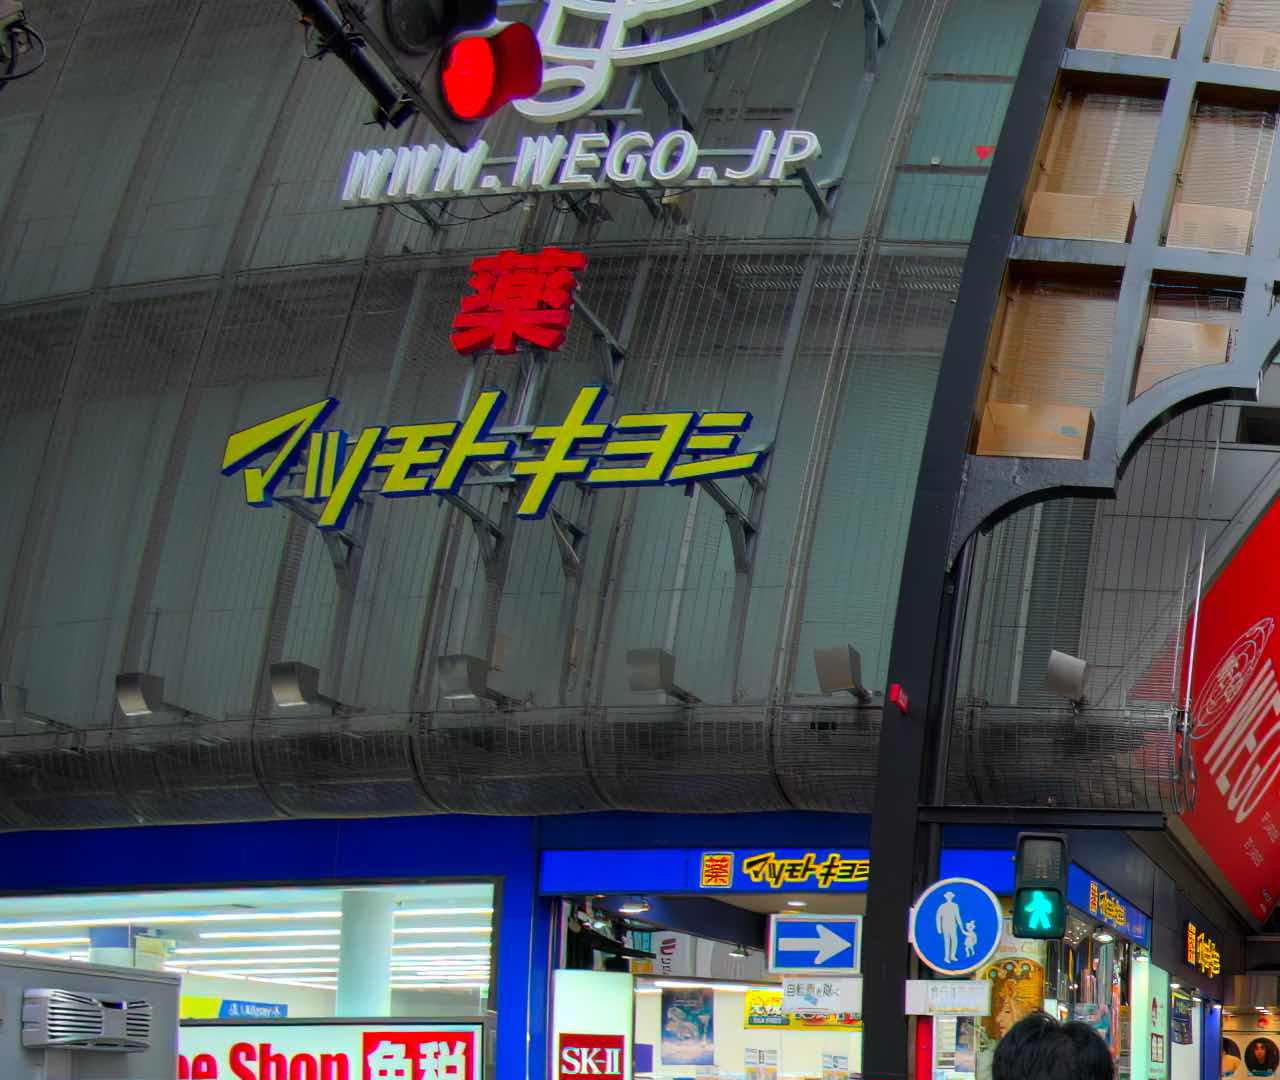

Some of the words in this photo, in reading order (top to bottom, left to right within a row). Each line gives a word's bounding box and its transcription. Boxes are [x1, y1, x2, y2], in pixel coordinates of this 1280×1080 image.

[342, 128, 822, 202] WWW.WEGO.JP
[449, 246, 589, 356] 薬
[221, 384, 772, 529] マツモトキヨシ
[705, 856, 728, 883] 薬
[561, 1047, 622, 1075] SK-II
